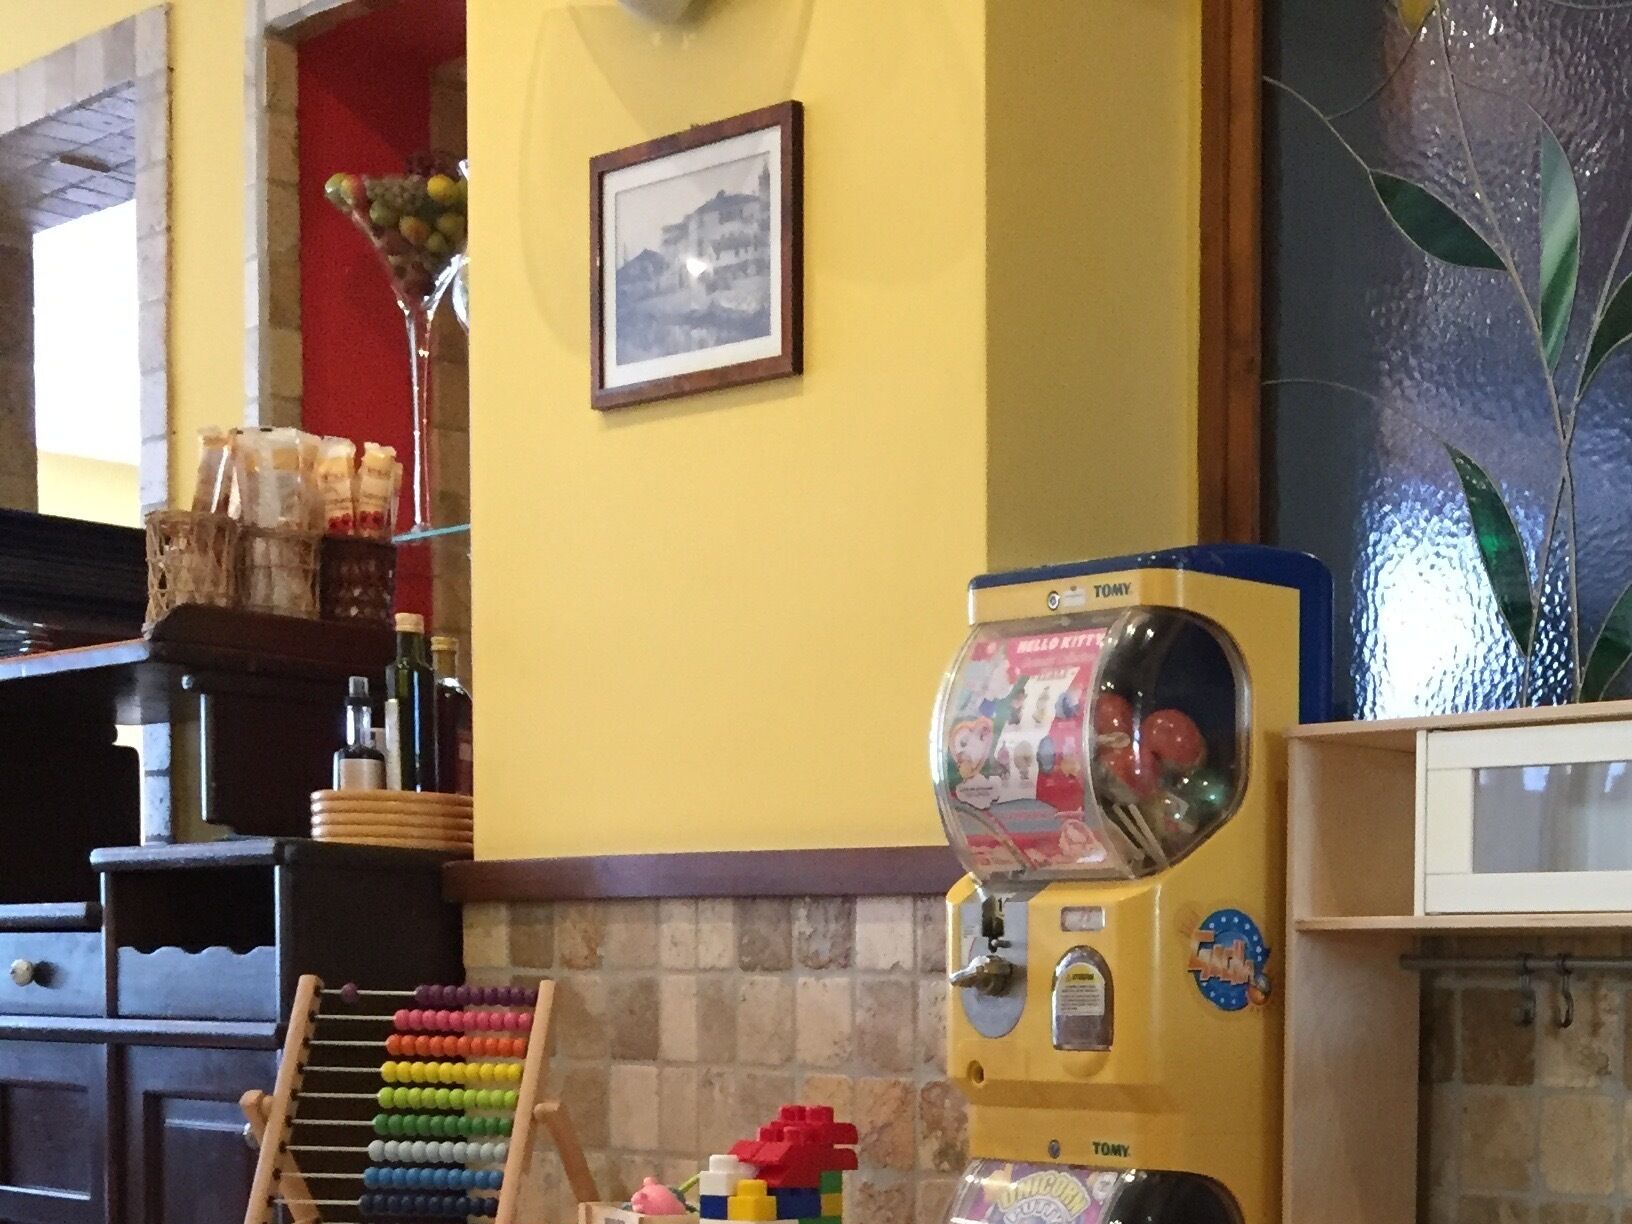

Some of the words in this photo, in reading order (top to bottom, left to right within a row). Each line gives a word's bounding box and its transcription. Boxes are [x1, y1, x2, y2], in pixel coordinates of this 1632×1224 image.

[1094, 582, 1131, 598] TOMY
[1017, 638, 1060, 653] HELLO
[1060, 632, 1106, 649] KITTY
[1092, 1141, 1130, 1157] TOMY
[998, 1172, 1089, 1217] UNICORN
